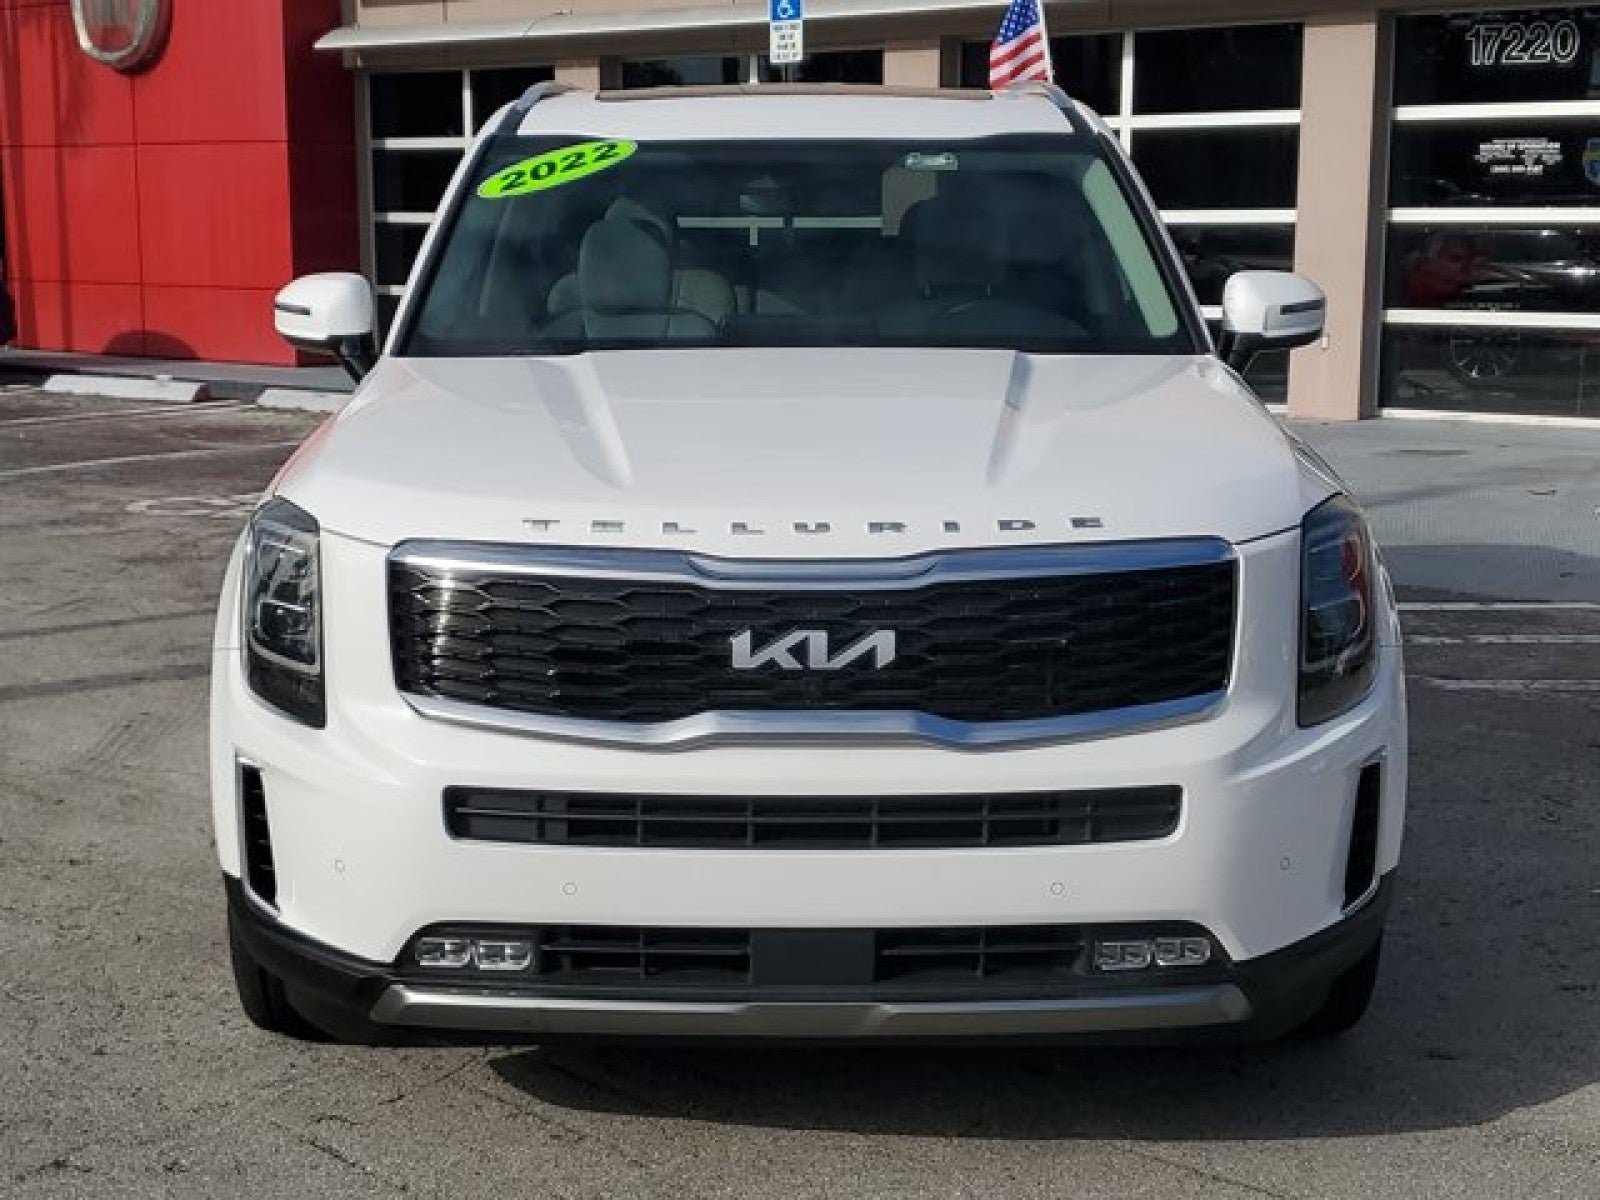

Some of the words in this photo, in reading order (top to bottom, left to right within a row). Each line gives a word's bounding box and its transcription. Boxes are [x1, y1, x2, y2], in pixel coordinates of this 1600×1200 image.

[1465, 20, 1580, 65] 17220
[501, 144, 620, 191] 2022
[523, 517, 1105, 534] TELLURIDE
[731, 629, 896, 671] KIA
